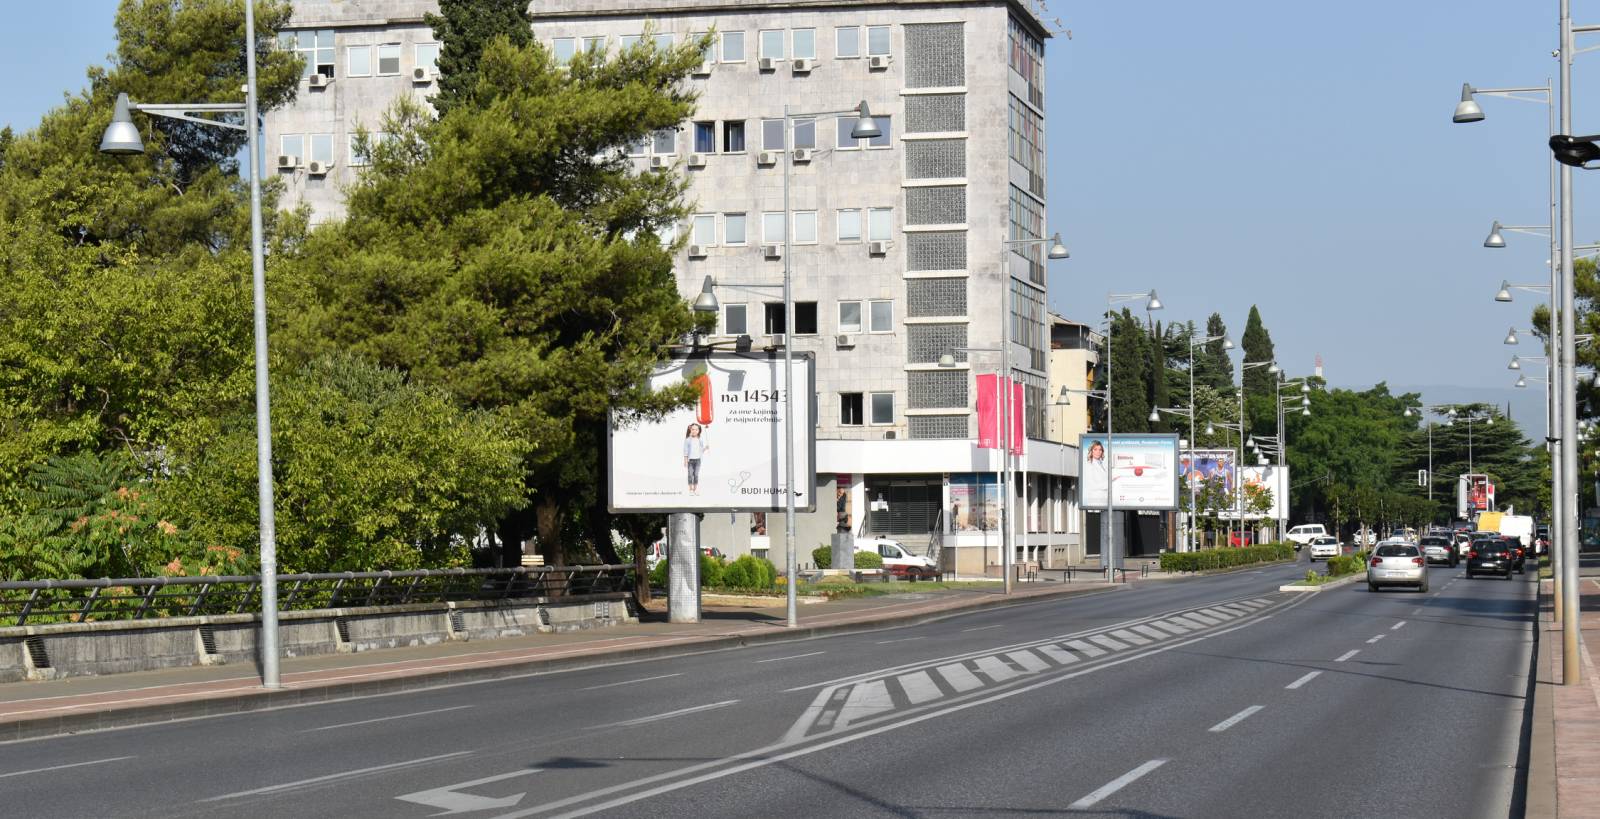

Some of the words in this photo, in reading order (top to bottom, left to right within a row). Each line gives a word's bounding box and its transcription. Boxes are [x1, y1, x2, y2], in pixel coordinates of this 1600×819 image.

[721, 393, 738, 403] na
[744, 389, 787, 403] 14543
[741, 487, 762, 495] BUDI
